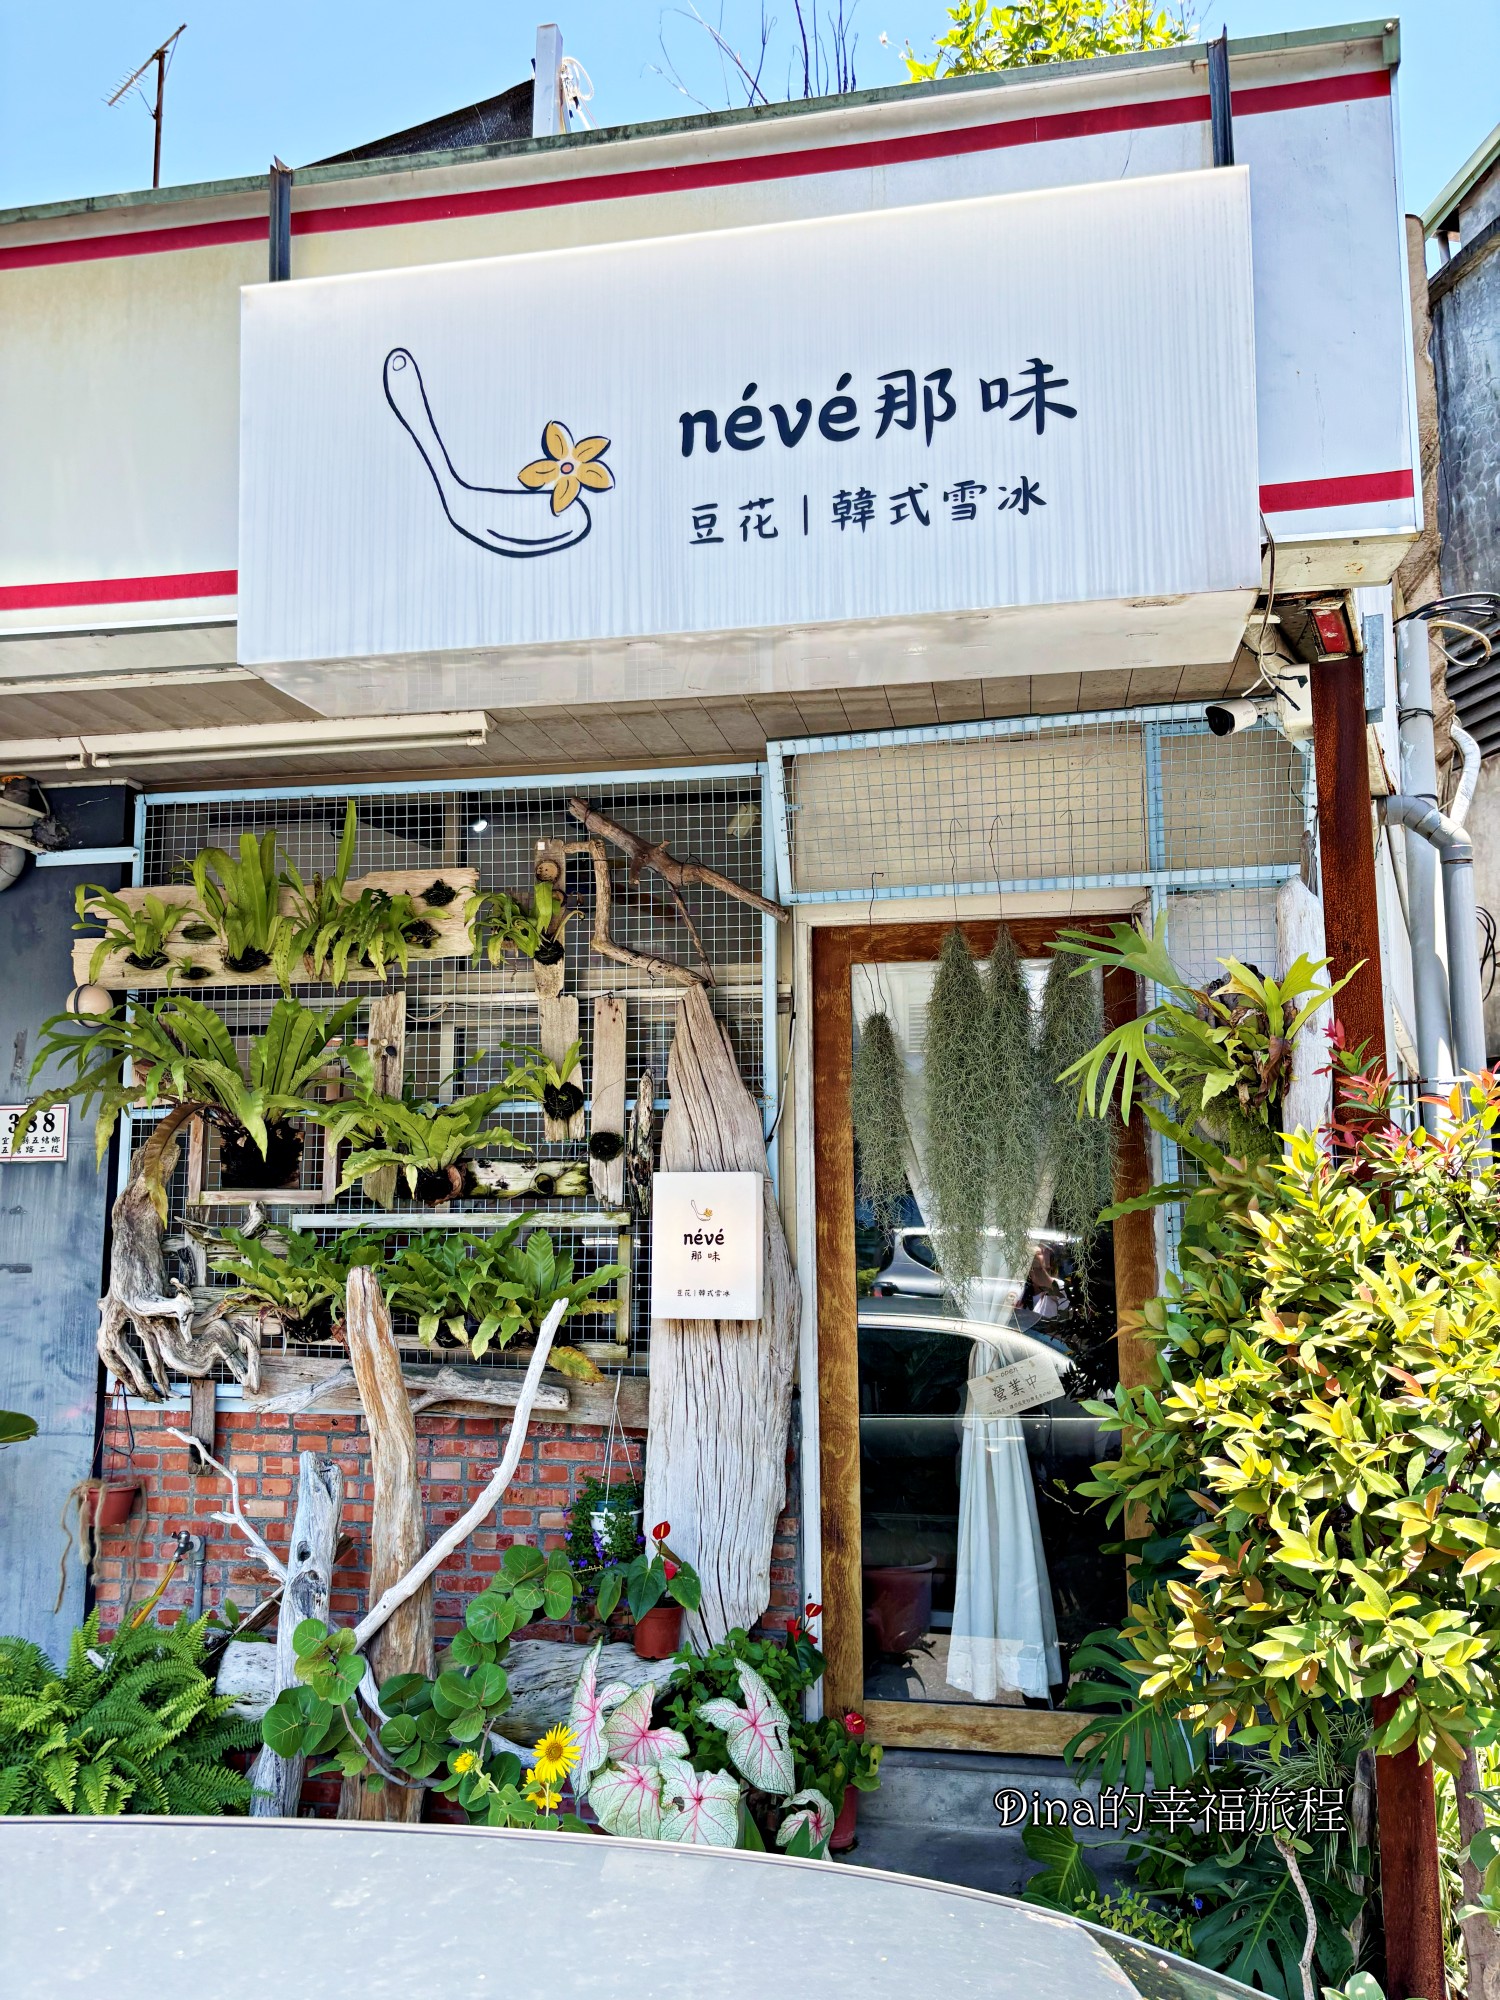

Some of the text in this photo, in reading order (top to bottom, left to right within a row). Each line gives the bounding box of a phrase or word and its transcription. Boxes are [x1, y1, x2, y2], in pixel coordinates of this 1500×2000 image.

[2, 1136, 61, 1145] 宜縣五結鄉
[683, 1228, 725, 1246] névé
[690, 1250, 721, 1263] 那味
[991, 1373, 1037, 1403] 營業中
